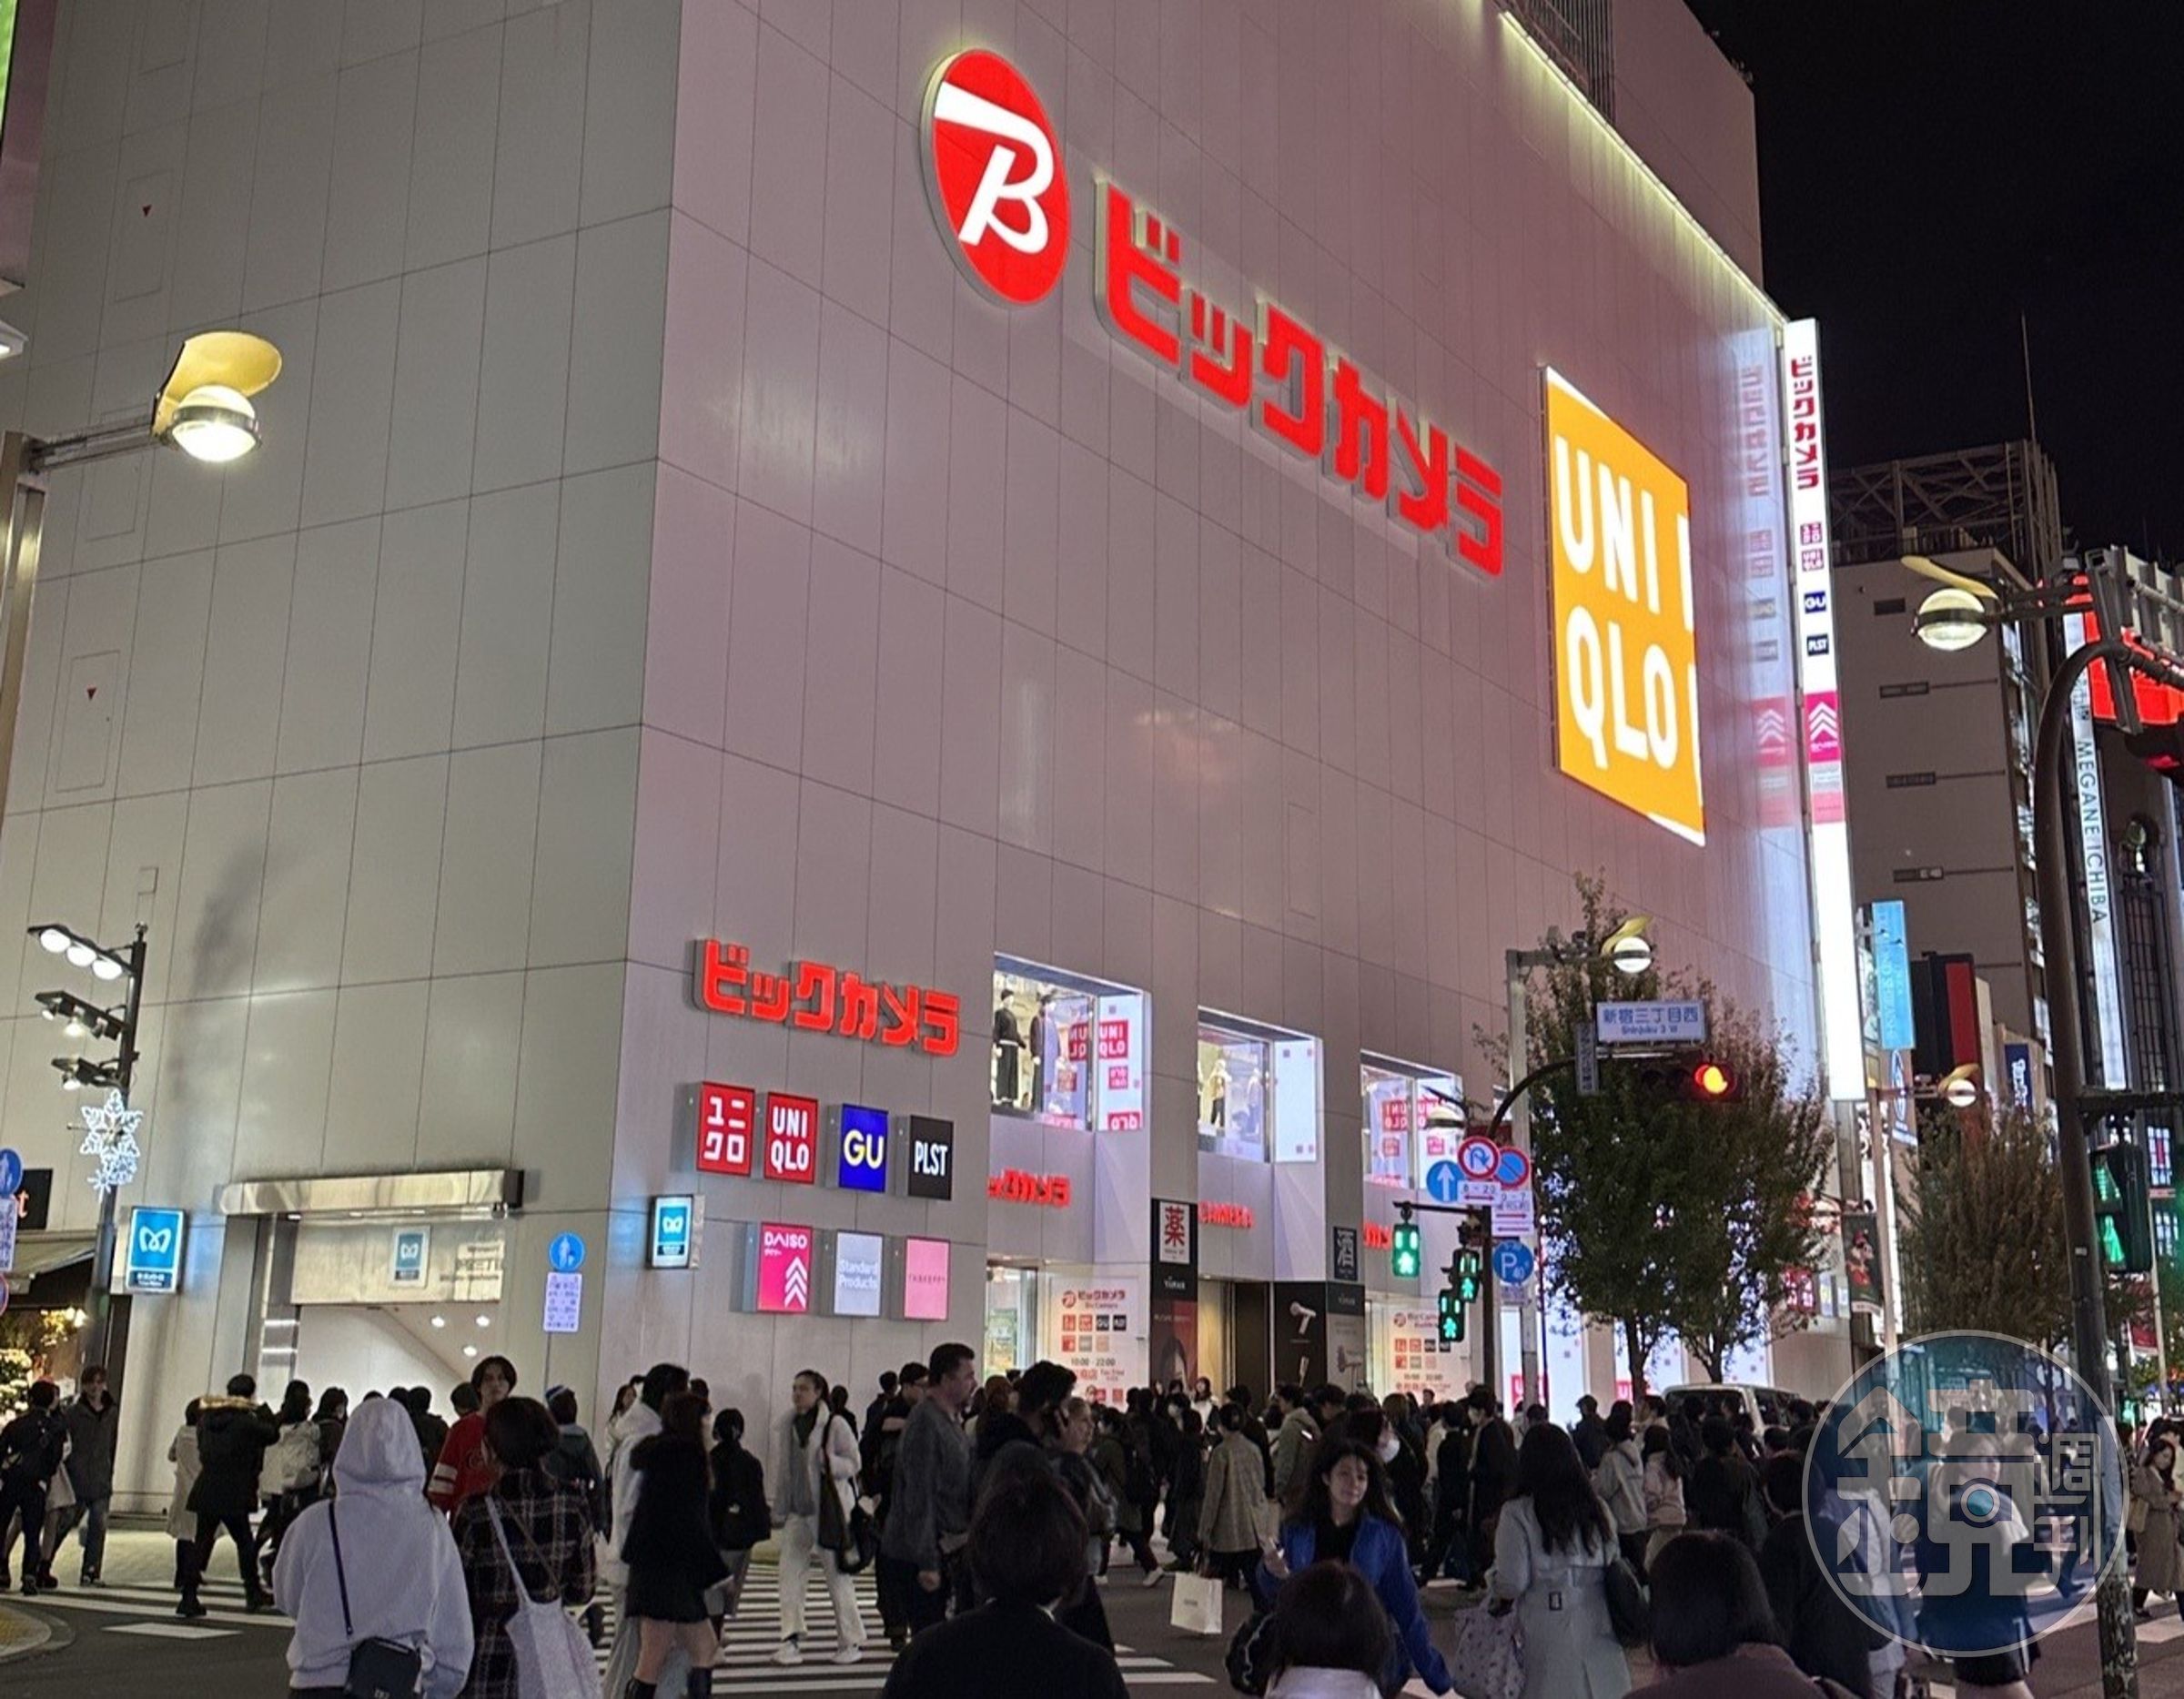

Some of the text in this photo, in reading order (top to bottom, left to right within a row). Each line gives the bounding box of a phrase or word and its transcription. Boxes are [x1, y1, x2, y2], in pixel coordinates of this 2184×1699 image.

[1106, 181, 1503, 578] ビックカメラ
[1791, 354, 1819, 490] ビックカメラ
[1554, 433, 1660, 616] UNI
[1805, 597, 1825, 610] GU
[1565, 604, 1679, 771] QLO
[2075, 740, 2108, 925] MEGANE ICHIBA
[703, 939, 959, 1056] ビックカメラ
[1099, 1022, 1124, 1039] UNI
[1603, 1006, 1698, 1024] 新宿三丁目西
[1099, 1042, 1126, 1057] QLO
[707, 1097, 746, 1129] ユニ
[772, 1106, 807, 1140] UNI
[703, 1133, 744, 1163] クロ
[771, 1139, 810, 1173] QLO
[843, 1128, 884, 1168] GU
[914, 1141, 949, 1177] PLST
[763, 1230, 807, 1249] DAISO
[1164, 1205, 1185, 1248] 薬
[1077, 1289, 1126, 1300] ビックカメラ
